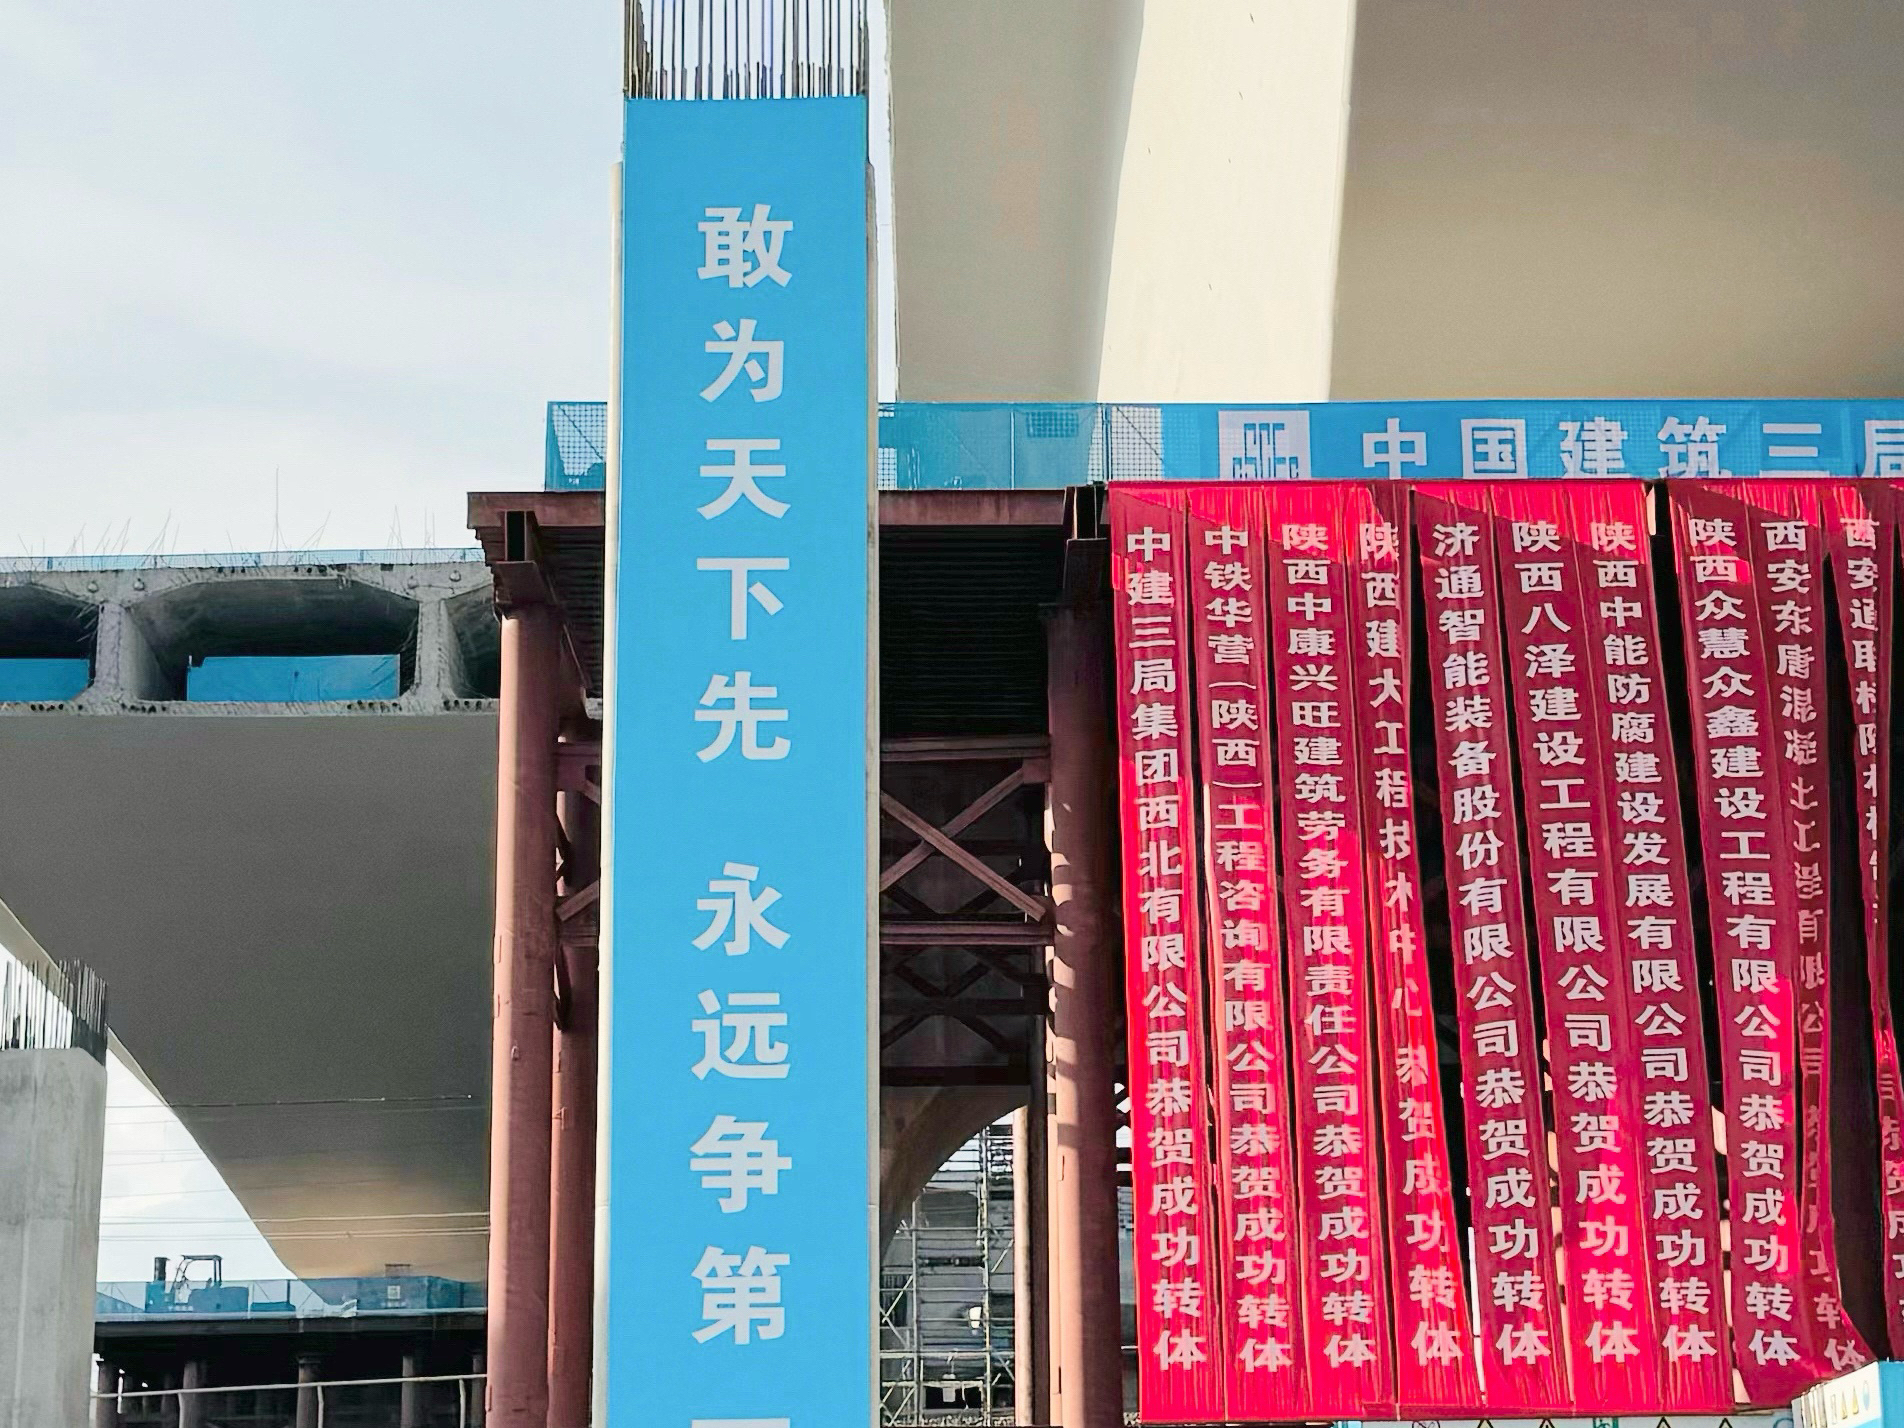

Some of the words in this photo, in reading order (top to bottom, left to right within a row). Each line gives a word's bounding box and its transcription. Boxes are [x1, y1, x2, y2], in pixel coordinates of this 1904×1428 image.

[693, 203, 794, 764] 敢为天下先
[1126, 527, 1207, 1370] 中建三局集团西北有限公司恭贺成功转体
[1282, 523, 1377, 1368] 陕西中康兴旺建筑劳务有限责任公司恭贺成功转体
[1432, 522, 1552, 1366] 济通智能装备股份有限公司恭贺成功转体
[1512, 521, 1640, 1365] 陕西八泽建设工程有限公司恭贺成功转体
[1590, 521, 1718, 1364] 陕西中能防腐建设发展有限公司恭贺成功转体
[1688, 517, 1801, 1368] 陕西众慧众鑫建设工程有限公司恭贺成功转体
